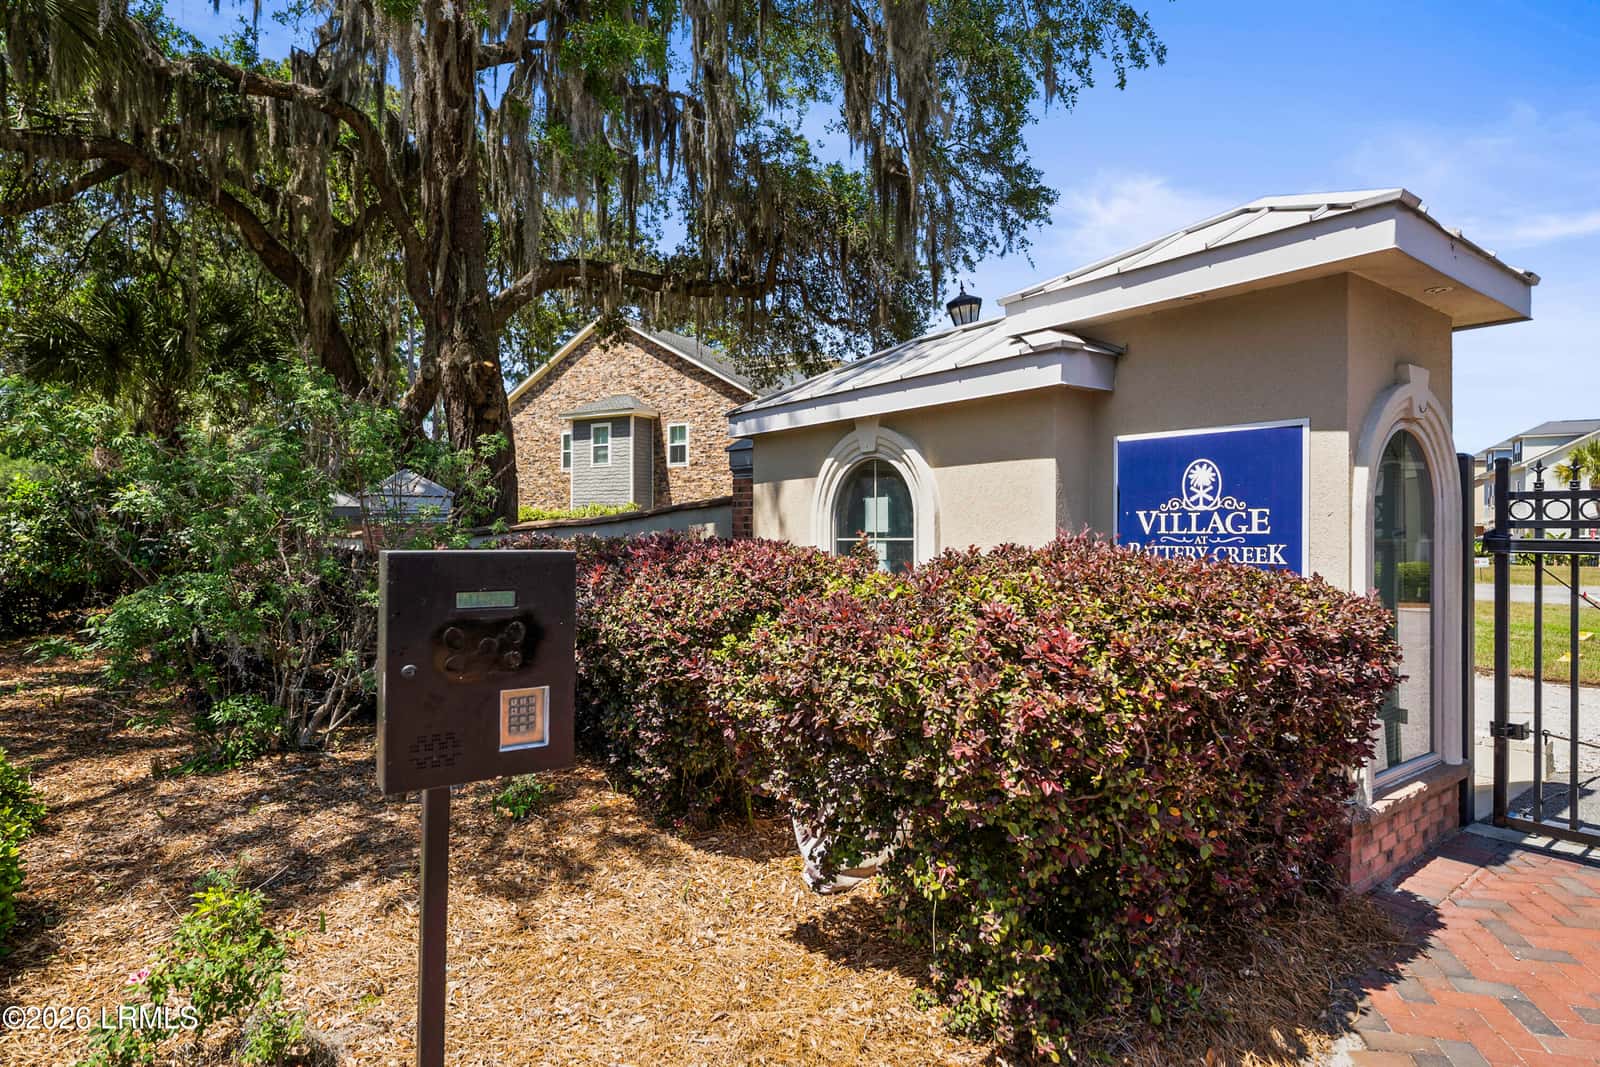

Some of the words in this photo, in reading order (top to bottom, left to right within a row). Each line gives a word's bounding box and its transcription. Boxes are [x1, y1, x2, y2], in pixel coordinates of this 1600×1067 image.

[1136, 508, 1271, 535] VILLAGE
[1194, 535, 1209, 545] AT
[1213, 544, 1288, 565] CREEK
